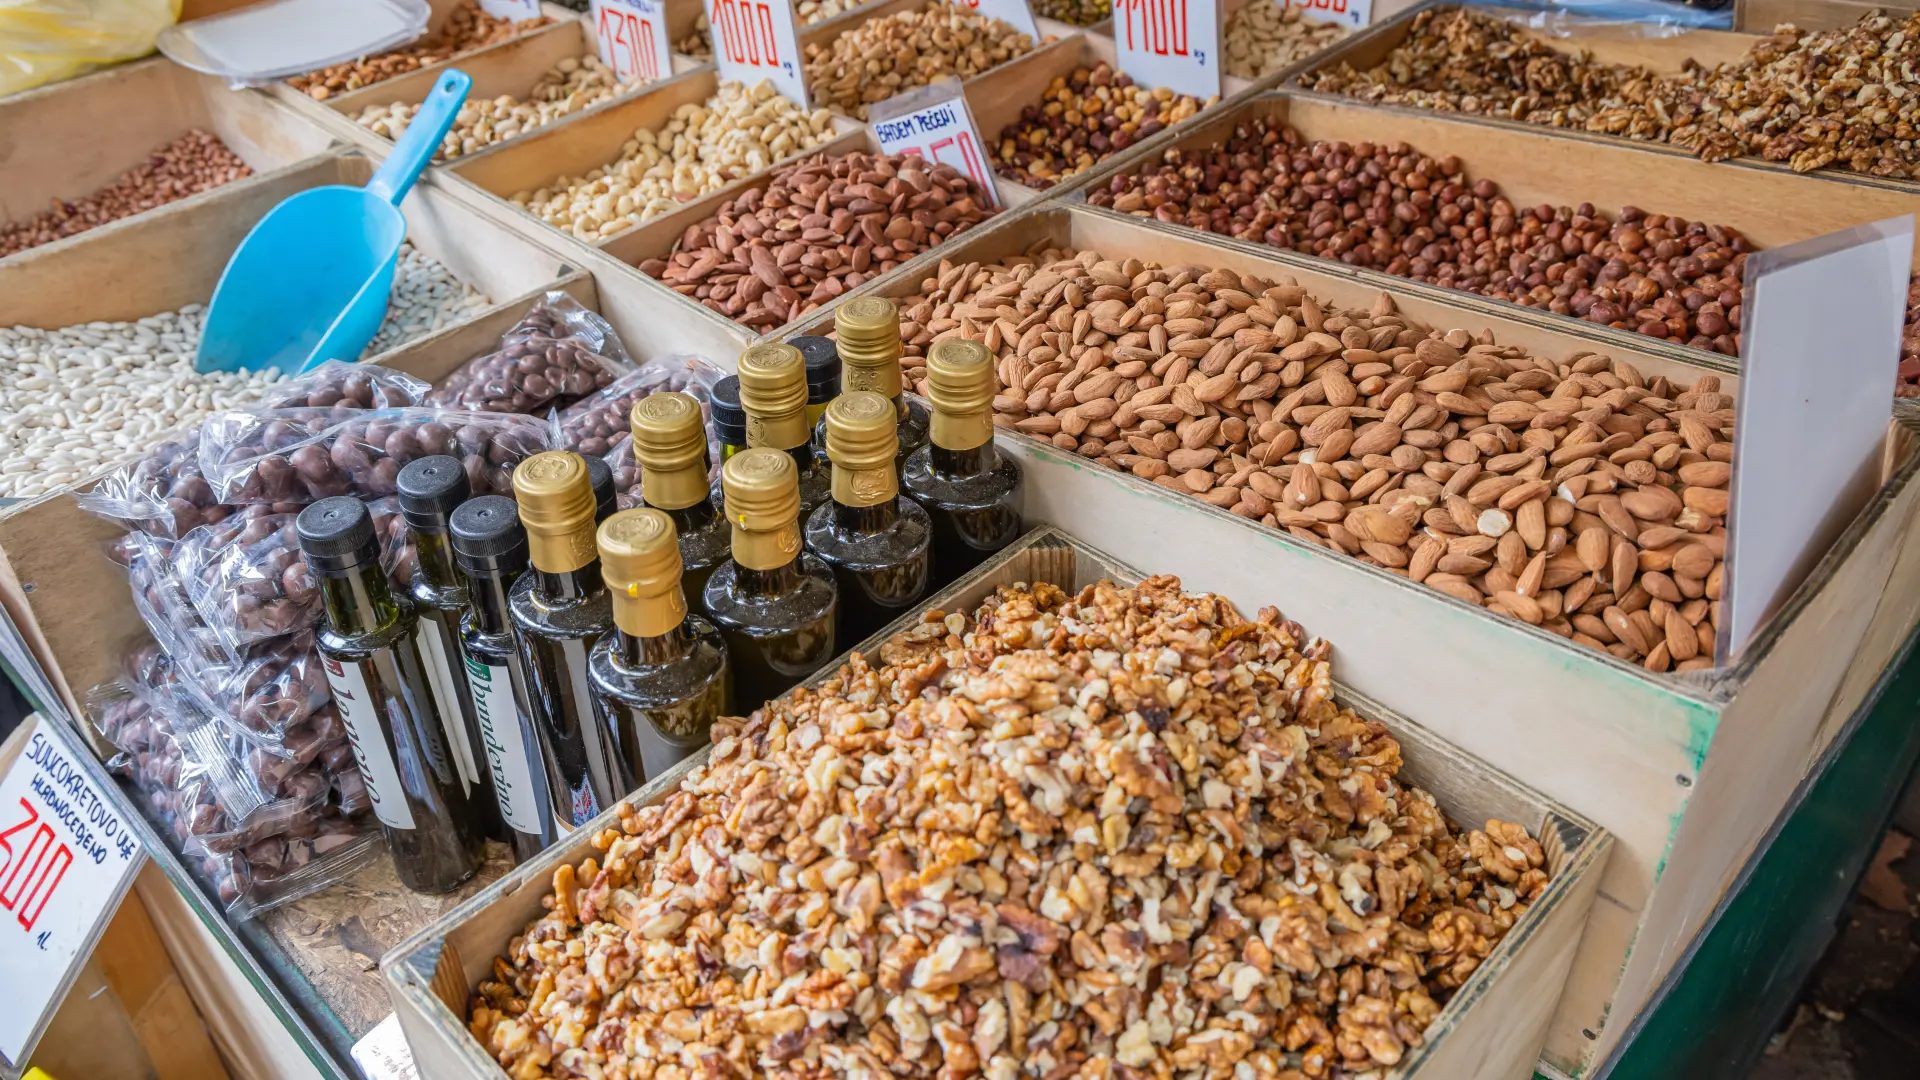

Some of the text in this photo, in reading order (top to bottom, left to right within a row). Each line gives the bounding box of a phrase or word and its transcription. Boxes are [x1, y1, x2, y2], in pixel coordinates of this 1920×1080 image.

[711, 0, 779, 67] 1000
[875, 112, 916, 144] BADEM
[25, 732, 118, 838] SUNCOKRETOVO
[472, 678, 513, 817] bundevino
